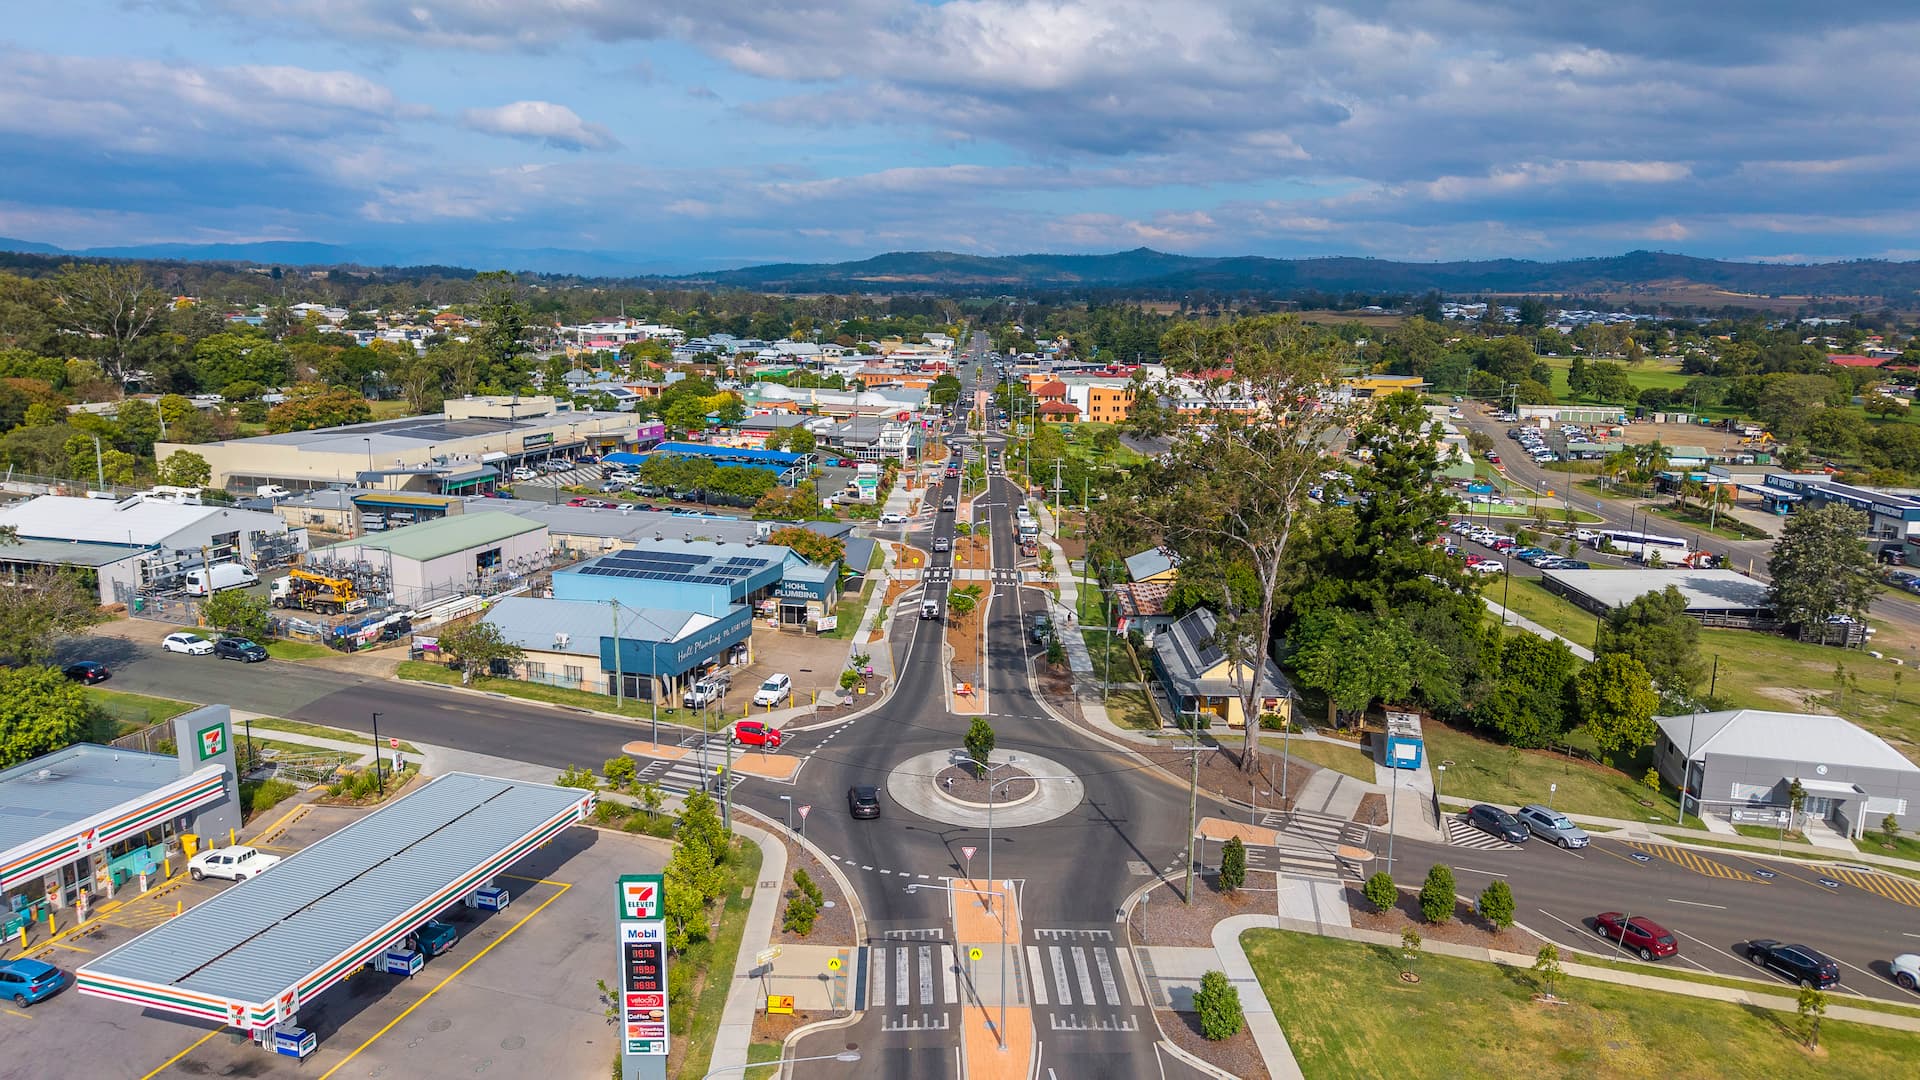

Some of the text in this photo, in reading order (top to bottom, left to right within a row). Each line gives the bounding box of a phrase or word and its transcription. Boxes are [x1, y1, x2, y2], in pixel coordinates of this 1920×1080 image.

[1767, 476, 1794, 490] CAR WASH
[784, 582, 808, 591] HOHL
[775, 589, 818, 599] PLUMBING
[677, 645, 694, 663] Hohl
[694, 632, 722, 655] Plumbing
[628, 930, 657, 938] Mobil
[630, 996, 657, 1006] velocity
